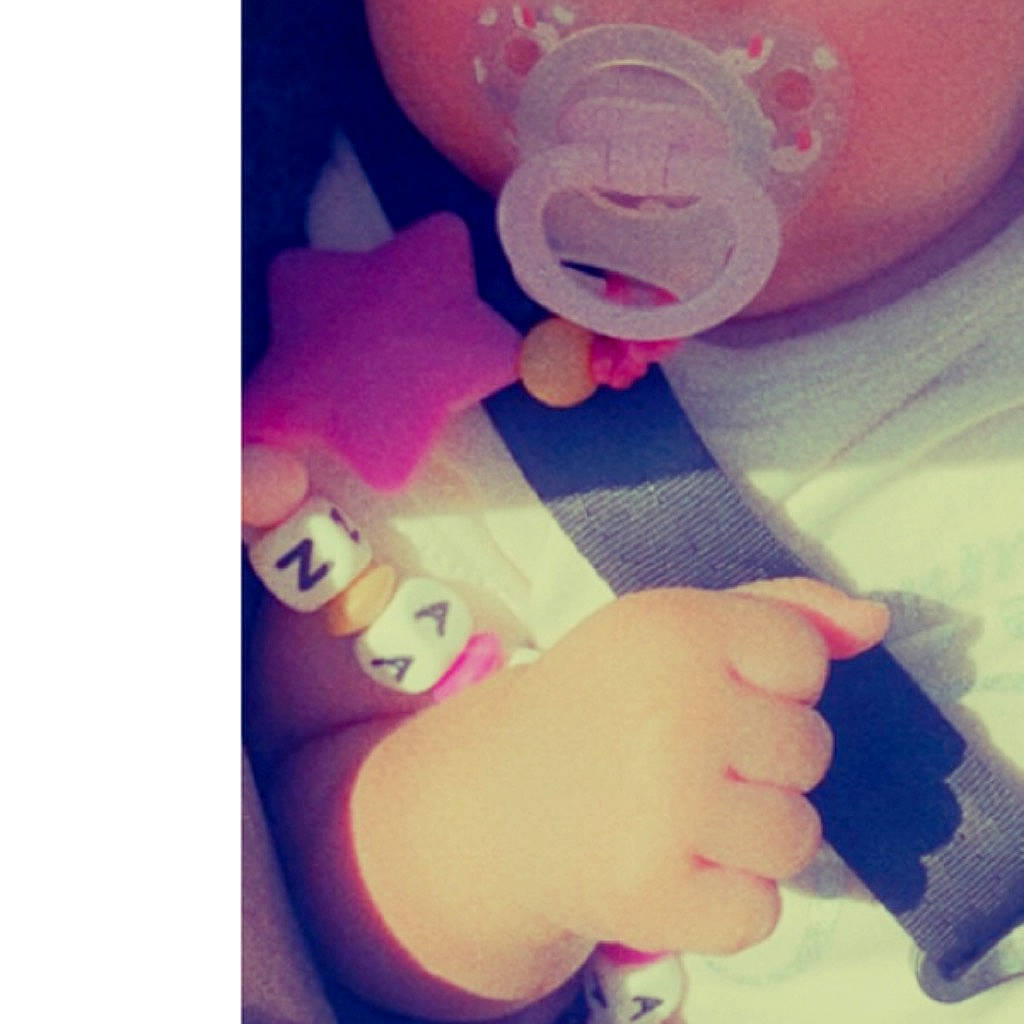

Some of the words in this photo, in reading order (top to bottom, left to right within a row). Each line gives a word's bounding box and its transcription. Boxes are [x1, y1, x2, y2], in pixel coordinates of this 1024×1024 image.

[275, 538, 331, 592] N
[414, 599, 450, 637] A
[370, 655, 413, 683] A
[629, 994, 664, 1022] A
